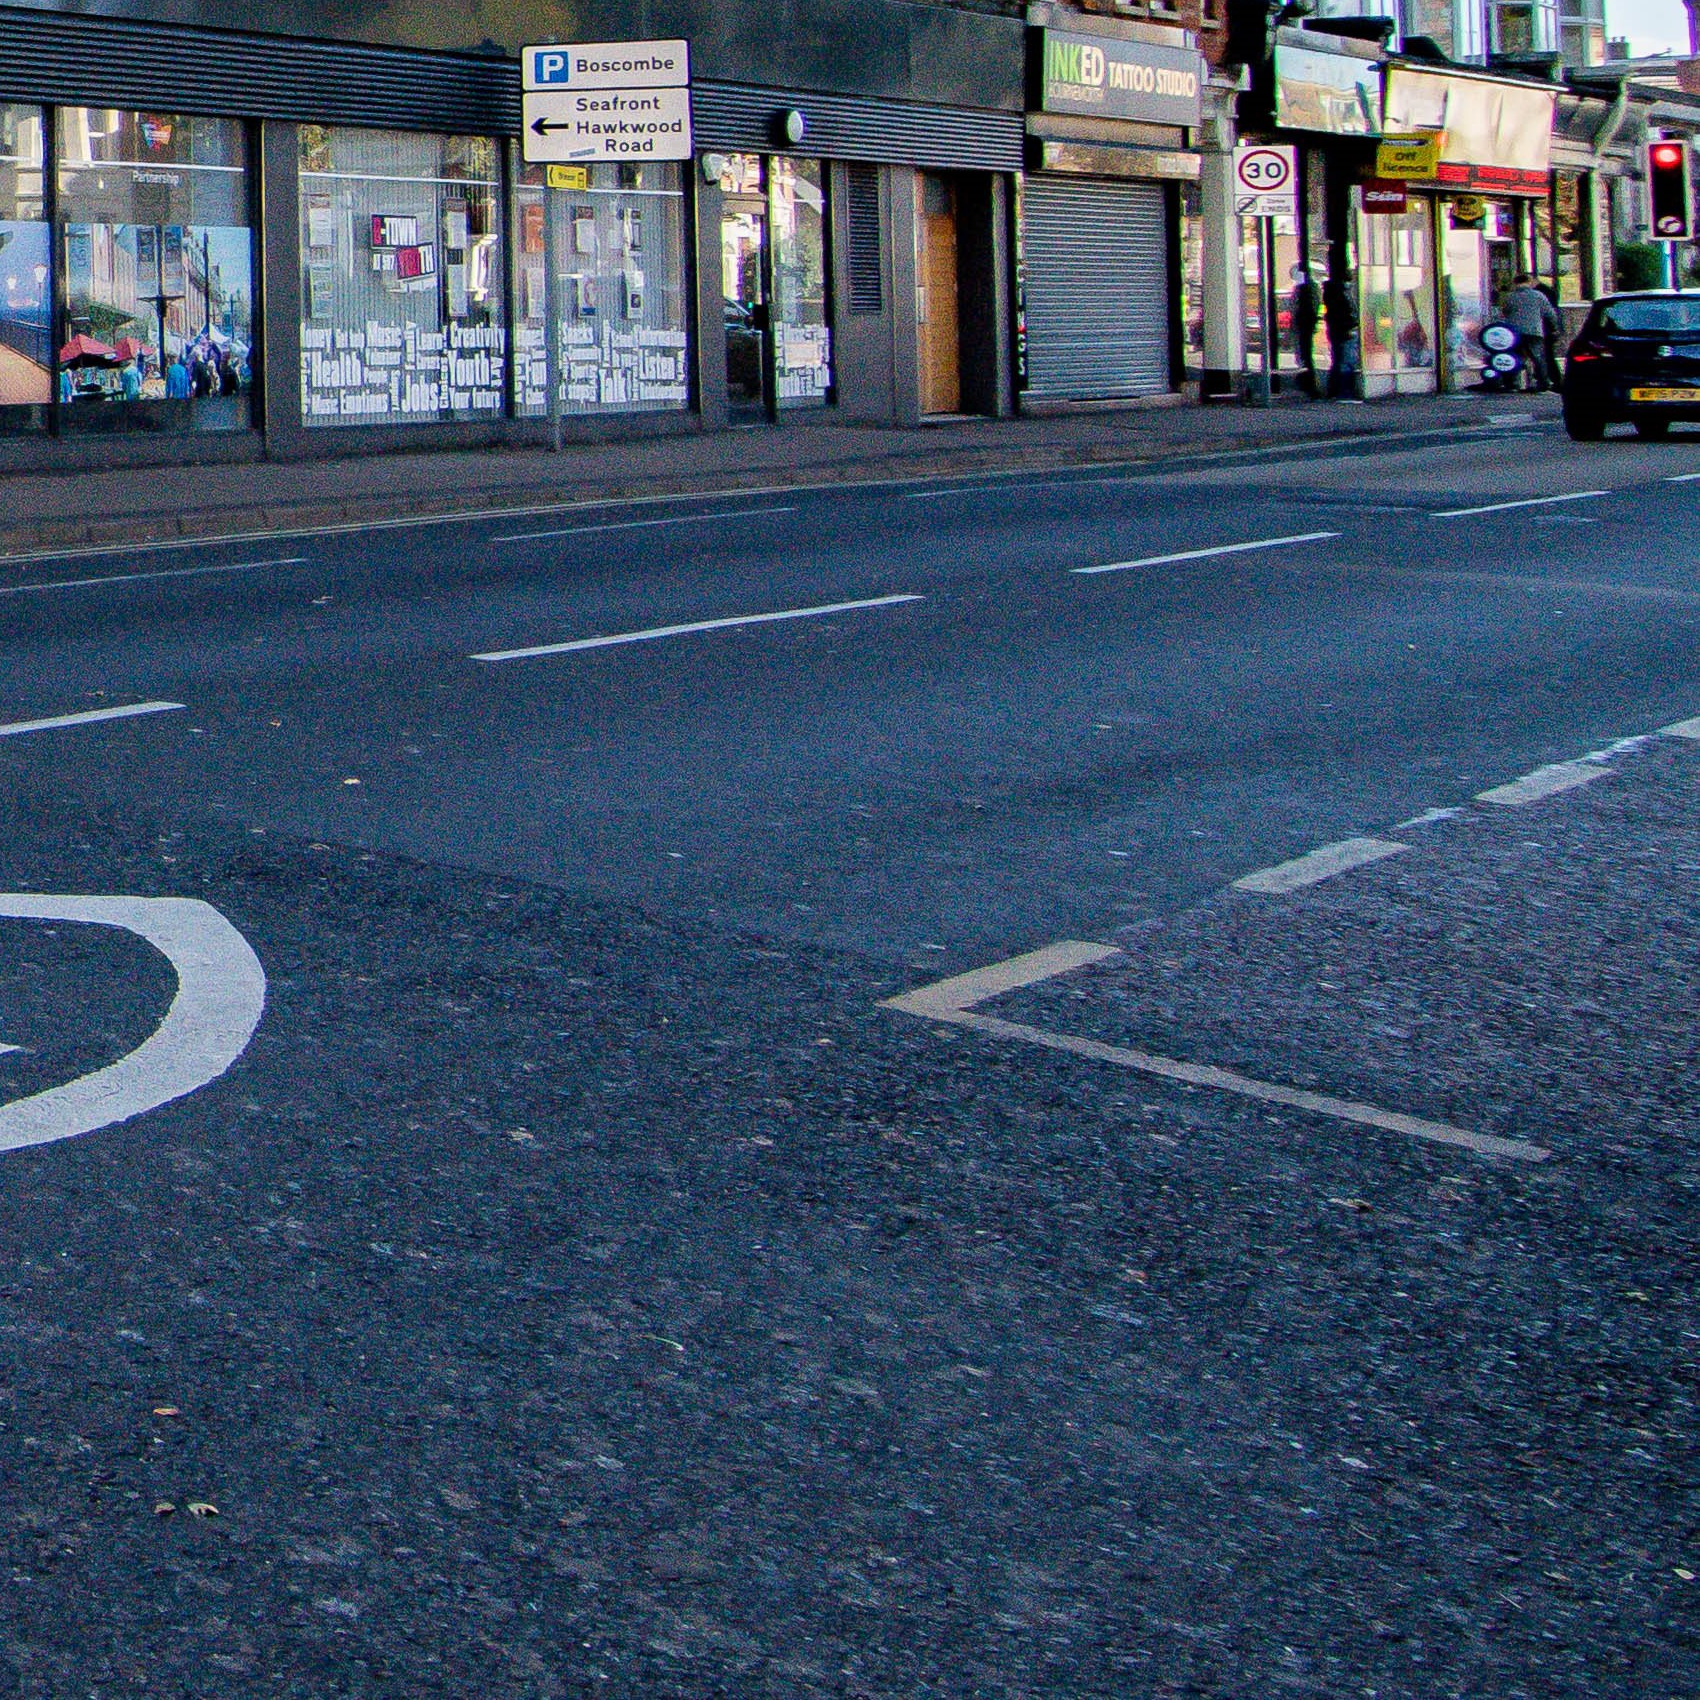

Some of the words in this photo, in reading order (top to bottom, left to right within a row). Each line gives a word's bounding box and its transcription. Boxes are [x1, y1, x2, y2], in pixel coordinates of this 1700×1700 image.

[576, 56, 675, 73] Boscombe
[1050, 41, 1104, 86] INKED
[1108, 61, 1155, 93] TATTOO
[1155, 68, 1197, 98] STUDIO
[575, 94, 661, 112] Seafront
[576, 118, 683, 135] Hawkwood
[605, 138, 654, 153] Road
[1246, 163, 1282, 179] 30
[449, 320, 506, 355] Creativity
[311, 350, 363, 388] Health
[448, 349, 491, 387] Youth
[401, 373, 439, 413] Jobs
